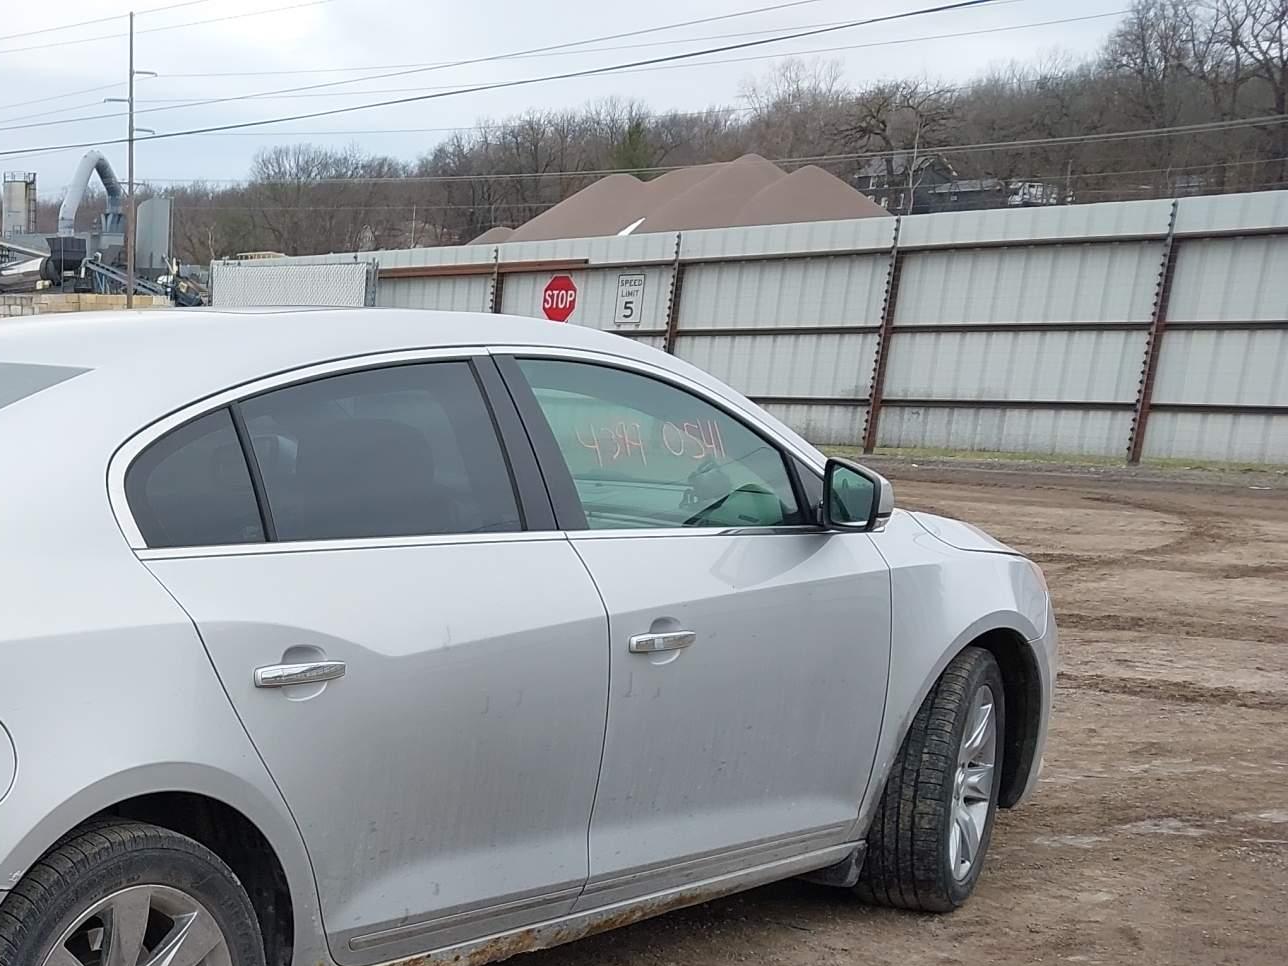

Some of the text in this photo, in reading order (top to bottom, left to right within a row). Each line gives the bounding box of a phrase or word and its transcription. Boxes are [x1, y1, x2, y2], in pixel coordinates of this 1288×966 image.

[620, 279, 643, 287] SPEED
[544, 289, 576, 308] STOP
[621, 289, 639, 298] LIMIT
[622, 301, 634, 319] 5
[662, 417, 726, 459] 0541
